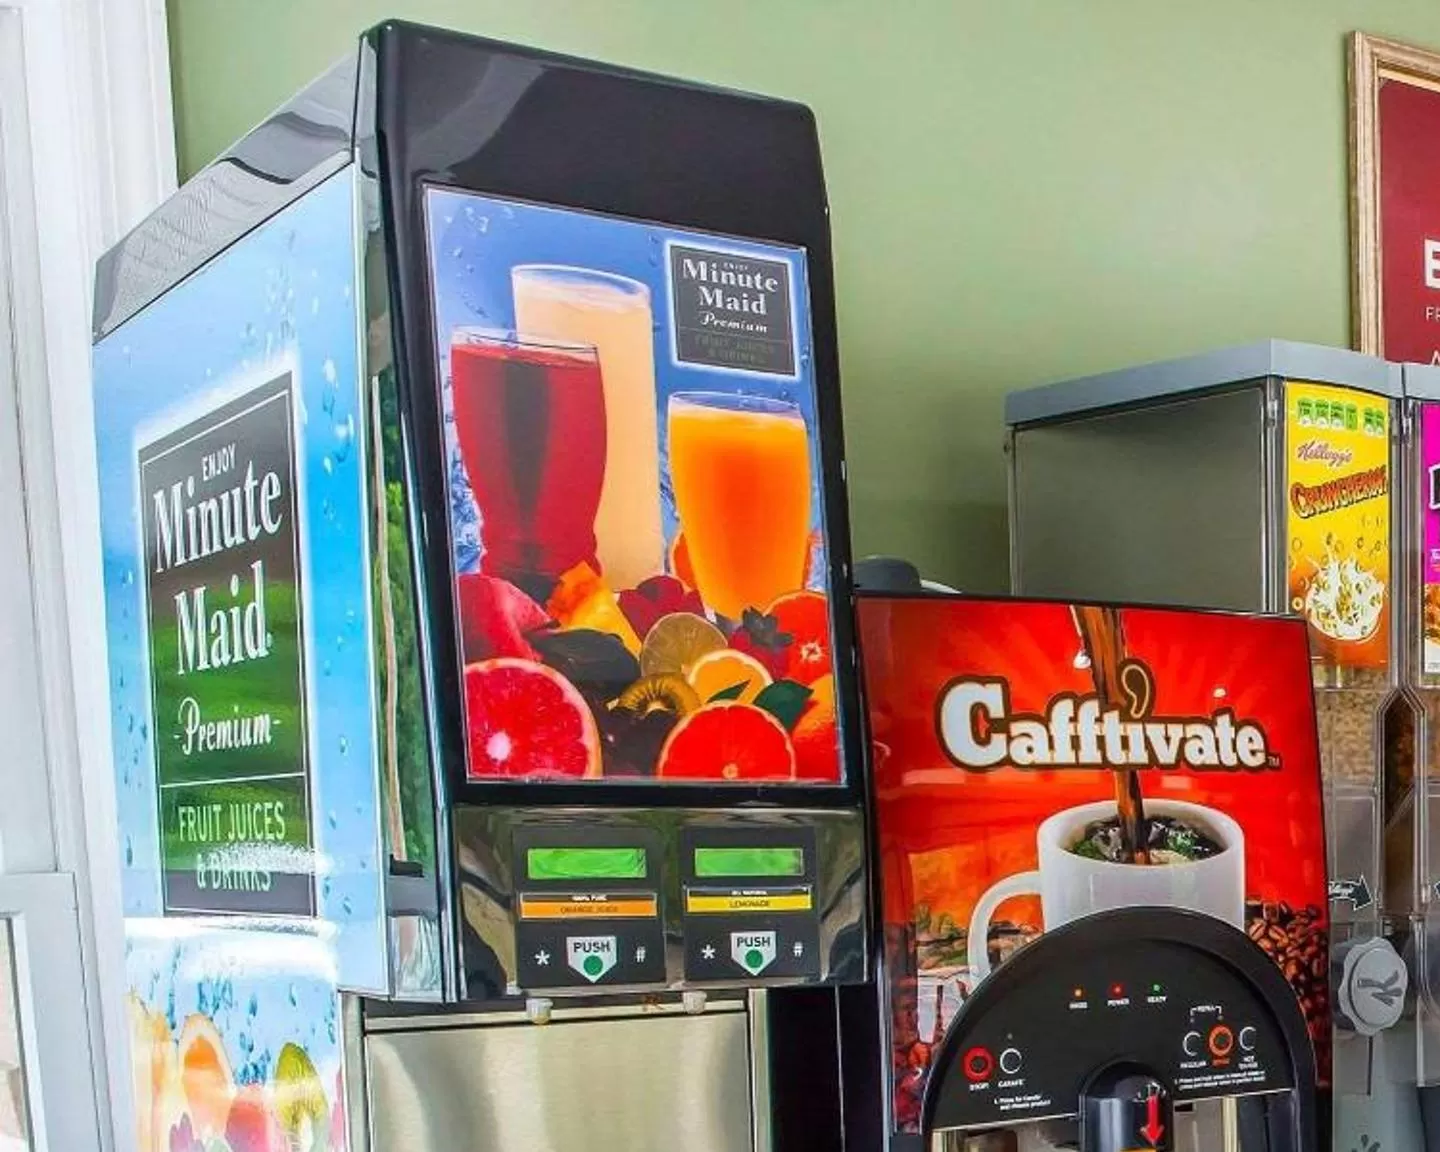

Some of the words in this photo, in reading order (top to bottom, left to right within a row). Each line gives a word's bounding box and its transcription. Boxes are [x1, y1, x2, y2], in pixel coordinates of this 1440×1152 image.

[682, 258, 779, 292] Minute
[698, 286, 767, 315] Maid
[700, 312, 768, 333] Premium
[202, 443, 237, 481] ENJOY
[153, 460, 282, 573] Minute
[174, 560, 270, 675] Maid
[940, 668, 1268, 769] Cafftivate
[178, 803, 221, 842] FRUIT
[228, 801, 286, 841] JUICES
[573, 941, 611, 953] PUSH
[736, 936, 771, 948] PUSH
